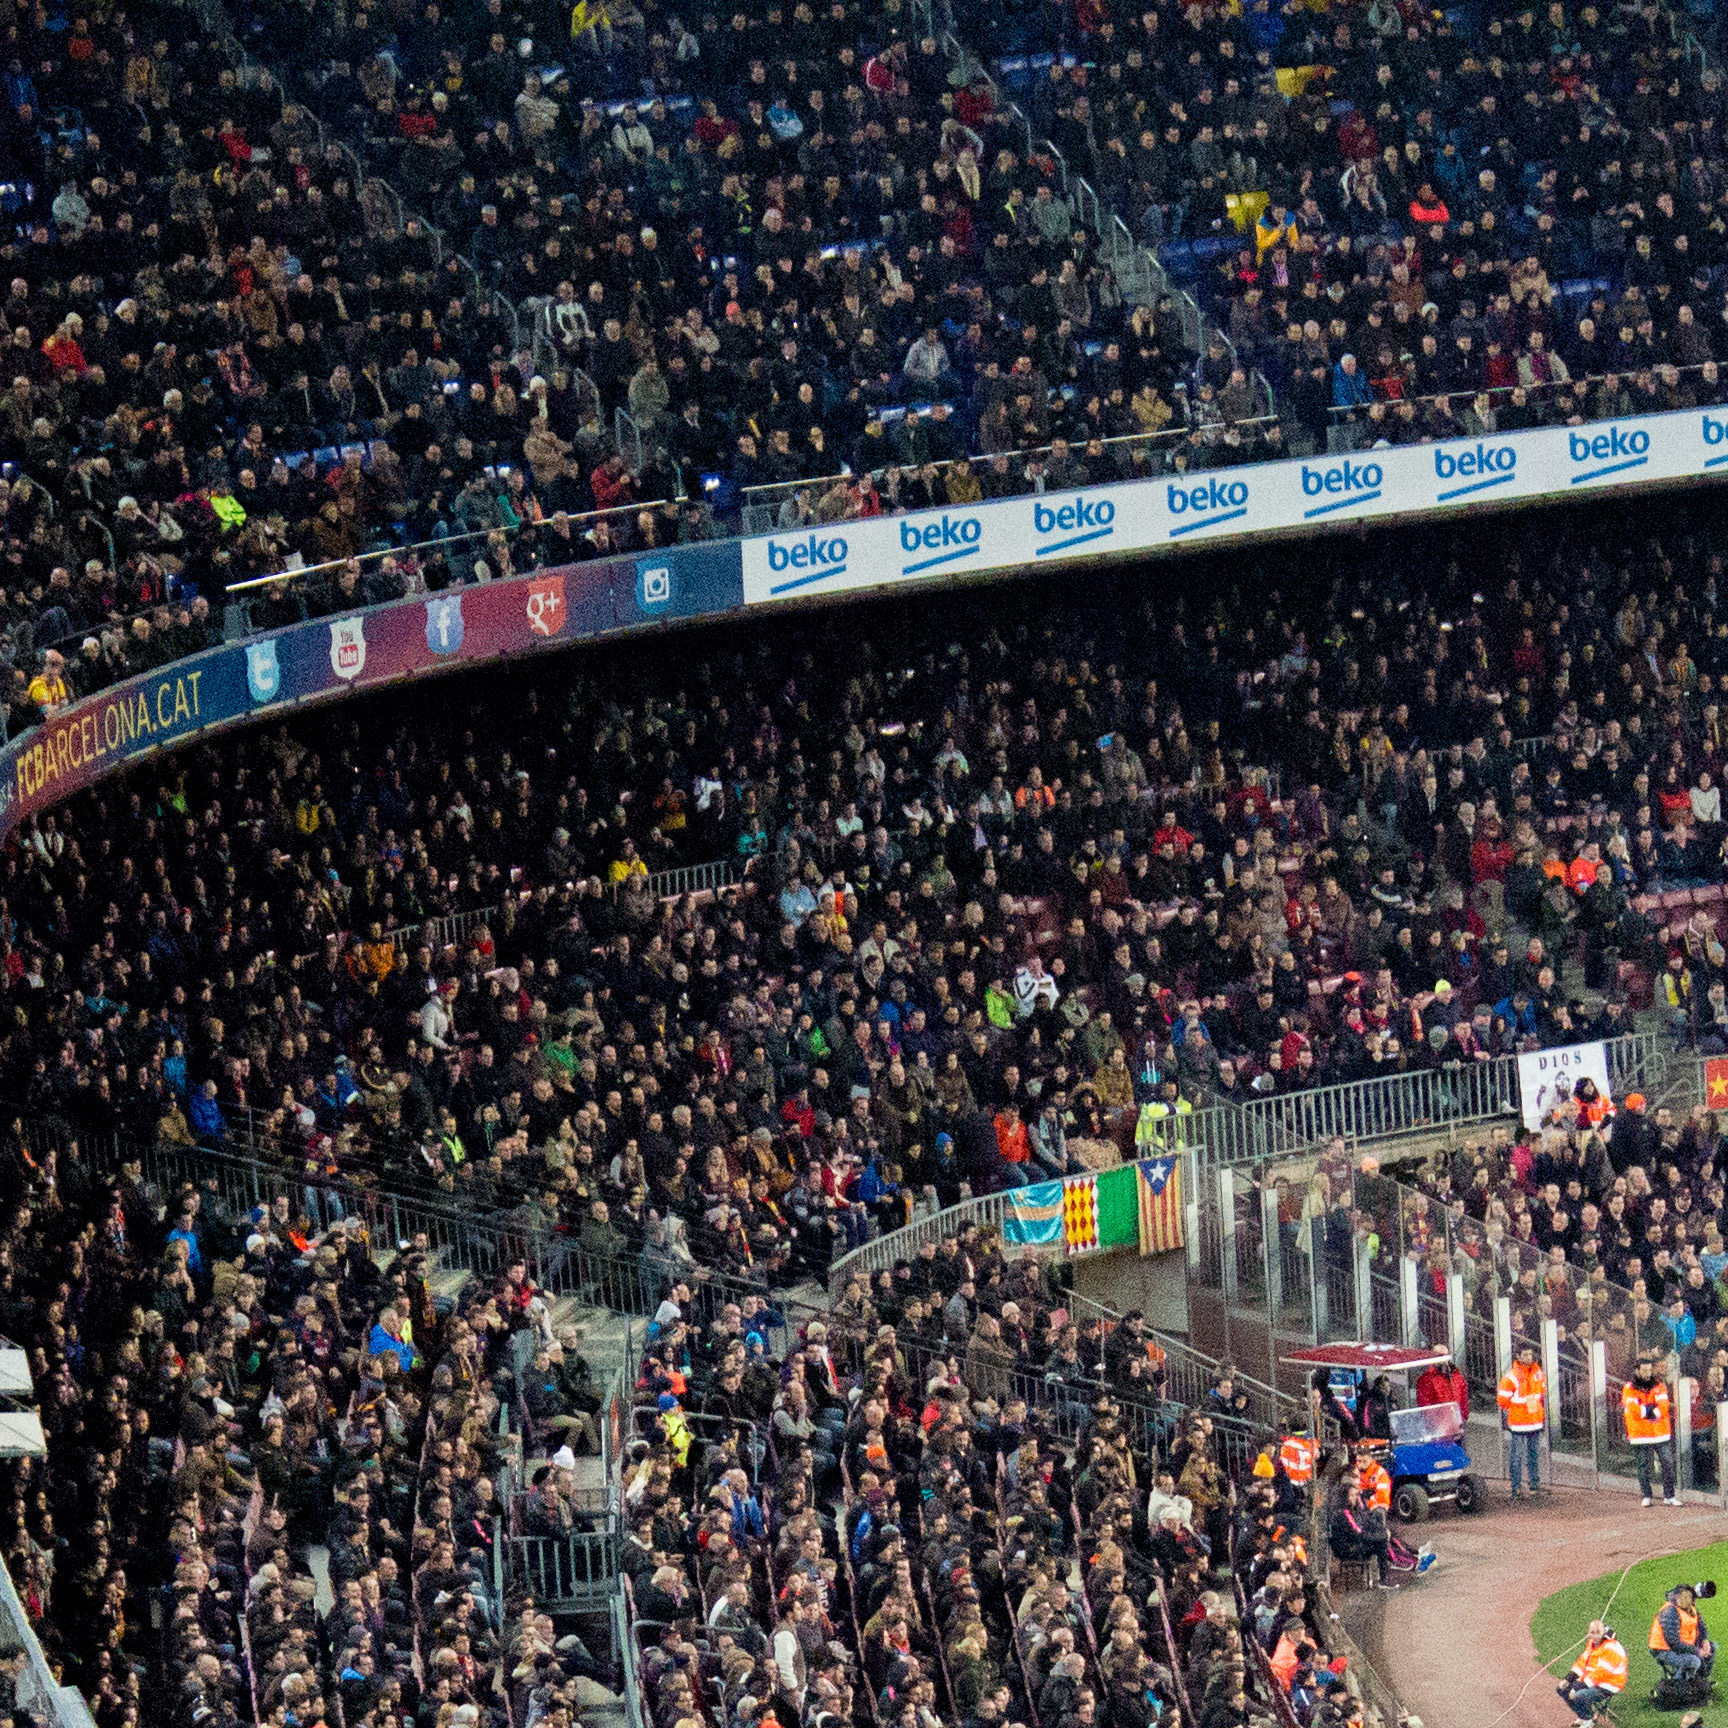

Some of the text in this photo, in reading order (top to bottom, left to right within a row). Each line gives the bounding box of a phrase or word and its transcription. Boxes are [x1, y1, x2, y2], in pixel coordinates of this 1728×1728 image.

[1433, 443, 1518, 480] beko
[1568, 426, 1651, 463] beko
[1166, 477, 1250, 515] beko
[1300, 460, 1384, 497] beko
[899, 514, 983, 553] beko
[1033, 497, 1116, 535] beko
[767, 534, 849, 573] beko
[16, 670, 203, 804] FCBARCELONA.CAT
